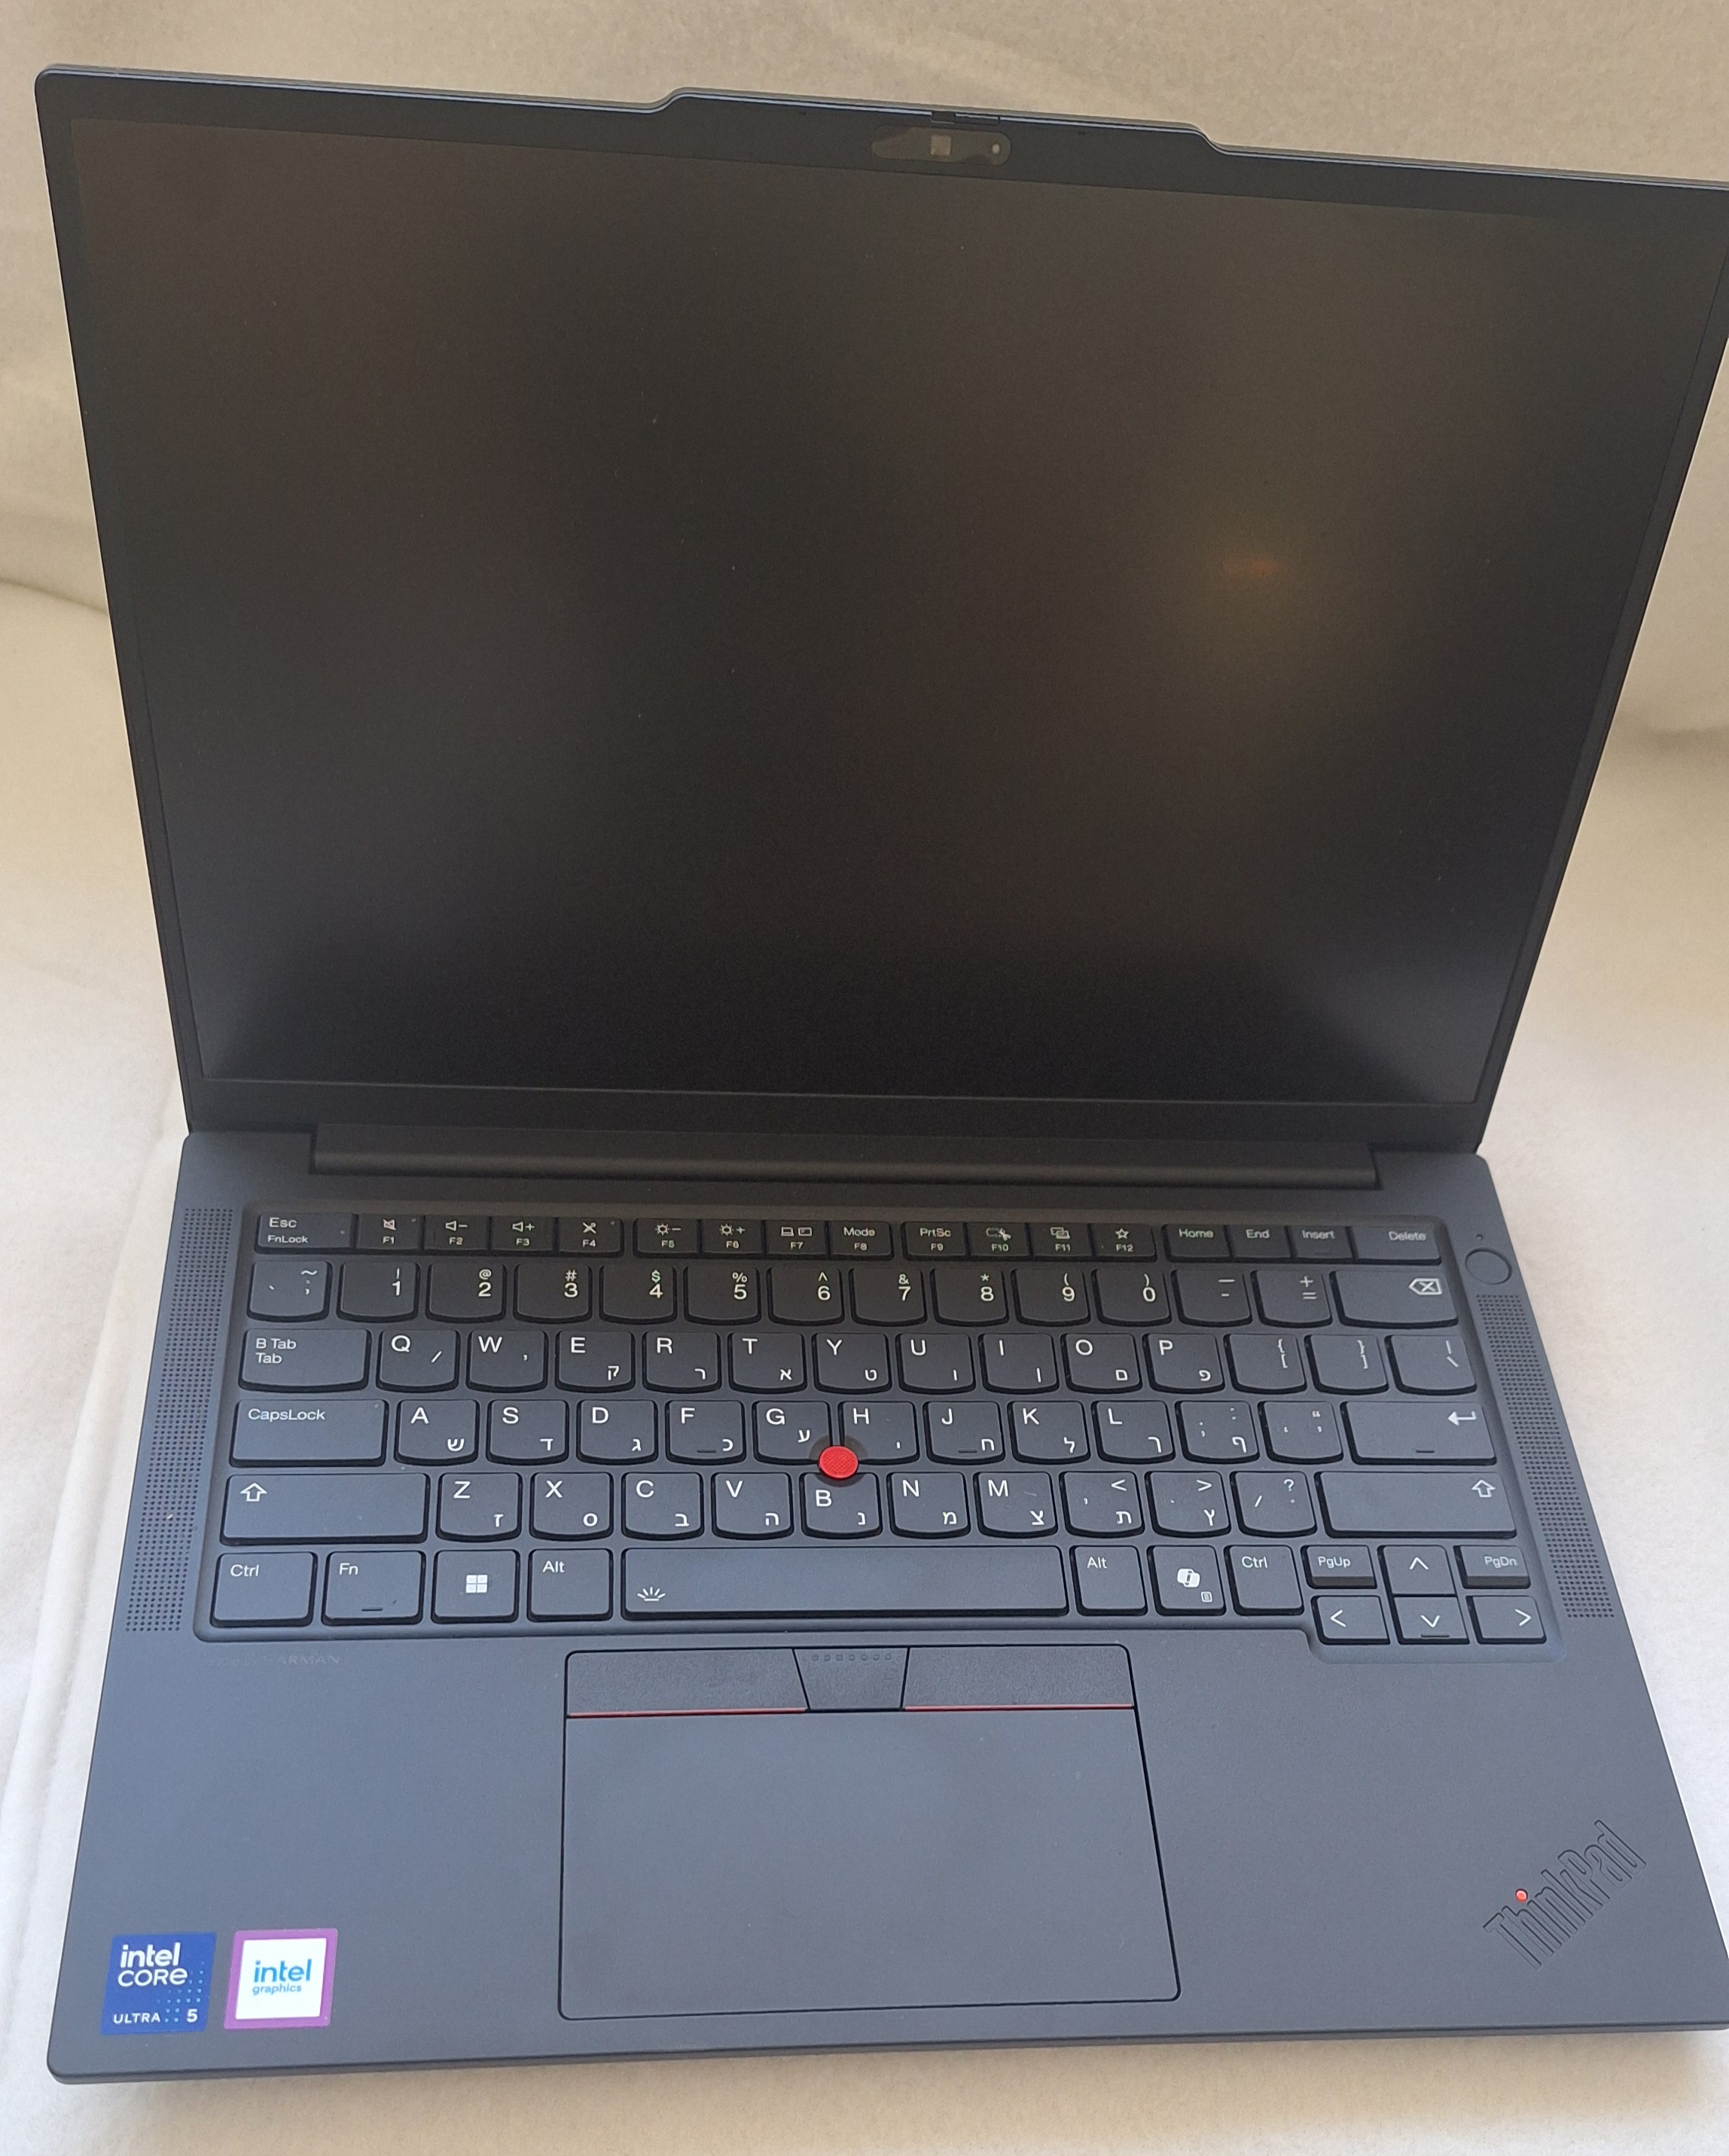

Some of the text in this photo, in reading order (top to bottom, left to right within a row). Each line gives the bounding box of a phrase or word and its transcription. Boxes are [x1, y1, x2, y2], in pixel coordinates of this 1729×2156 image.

[270, 1218, 297, 1227] Esc
[844, 1227, 875, 1236] Mode
[920, 1228, 950, 1237] PrtSc
[1179, 1229, 1213, 1237] Home
[1246, 1229, 1270, 1238] End
[1302, 1230, 1334, 1239] Insert
[1389, 1231, 1426, 1240] Delete
[392, 1281, 400, 1295] 1
[479, 1282, 491, 1296] 2
[565, 1283, 578, 1297] 3
[650, 1284, 663, 1298] 4
[734, 1285, 746, 1299] 5
[819, 1286, 830, 1300] 6
[899, 1286, 910, 1301] 7
[981, 1287, 993, 1301] 8
[1063, 1287, 1075, 1301] 9
[1143, 1288, 1155, 1301] 0
[256, 1338, 296, 1349] B Tab
[392, 1335, 410, 1352] Q
[478, 1337, 502, 1352] W
[572, 1337, 585, 1352] E
[657, 1337, 672, 1353] R
[743, 1338, 758, 1354] T
[827, 1340, 842, 1355] Y
[911, 1340, 925, 1355] U
[999, 1340, 1004, 1356] I
[1076, 1340, 1093, 1355] O
[1159, 1340, 1172, 1355] P
[256, 1352, 282, 1363] Tab
[608, 1366, 619, 1380] ק
[695, 1369, 705, 1380] ר
[780, 1369, 791, 1380] א
[865, 1370, 877, 1380] ט
[1116, 1370, 1127, 1380] ם
[1199, 1371, 1210, 1381] פ
[249, 1409, 325, 1422] CapsLock
[411, 1407, 428, 1423] A
[503, 1407, 518, 1423] S
[593, 1407, 608, 1423] D
[682, 1407, 694, 1423] F
[767, 1408, 785, 1424] G
[853, 1408, 869, 1424] H
[942, 1409, 952, 1424] J
[1023, 1408, 1039, 1424] K
[1108, 1408, 1122, 1424] L
[798, 1430, 810, 1442] ע
[448, 1439, 464, 1451] ש
[540, 1438, 553, 1450] ד
[632, 1439, 641, 1451] ג
[723, 1439, 733, 1451] כ
[981, 1439, 994, 1450] ח
[1064, 1437, 1075, 1453] ל
[1148, 1437, 1161, 1453] ך
[1232, 1437, 1246, 1453] ף
[454, 1481, 470, 1498] Z
[546, 1481, 562, 1497] X
[636, 1481, 654, 1497] C
[726, 1481, 743, 1497] V
[903, 1480, 919, 1496] N
[988, 1480, 1008, 1496] M
[816, 1490, 831, 1506] B
[494, 1514, 503, 1526] ז
[584, 1514, 597, 1526] ס
[675, 1514, 689, 1526] ב
[766, 1513, 779, 1525] ה
[858, 1512, 865, 1525] נ
[943, 1512, 956, 1524] מ
[1030, 1511, 1044, 1525] צ
[1116, 1511, 1131, 1523] ת
[1204, 1510, 1215, 1526] ץ
[340, 1563, 358, 1575] Fn
[543, 1561, 564, 1572] Alt
[1087, 1557, 1107, 1568] Alt
[1242, 1557, 1267, 1568] Ctrl
[1318, 1557, 1350, 1568] PgUp
[1484, 1557, 1517, 1568] PgDn
[230, 1565, 259, 1576] Ctrl
[1483, 1819, 1646, 1970] ThinkPad
[120, 1943, 180, 1968] intel
[254, 1959, 312, 1982] intel
[252, 1984, 302, 1996] graphics
[114, 2009, 197, 2024] ULTRA 5
